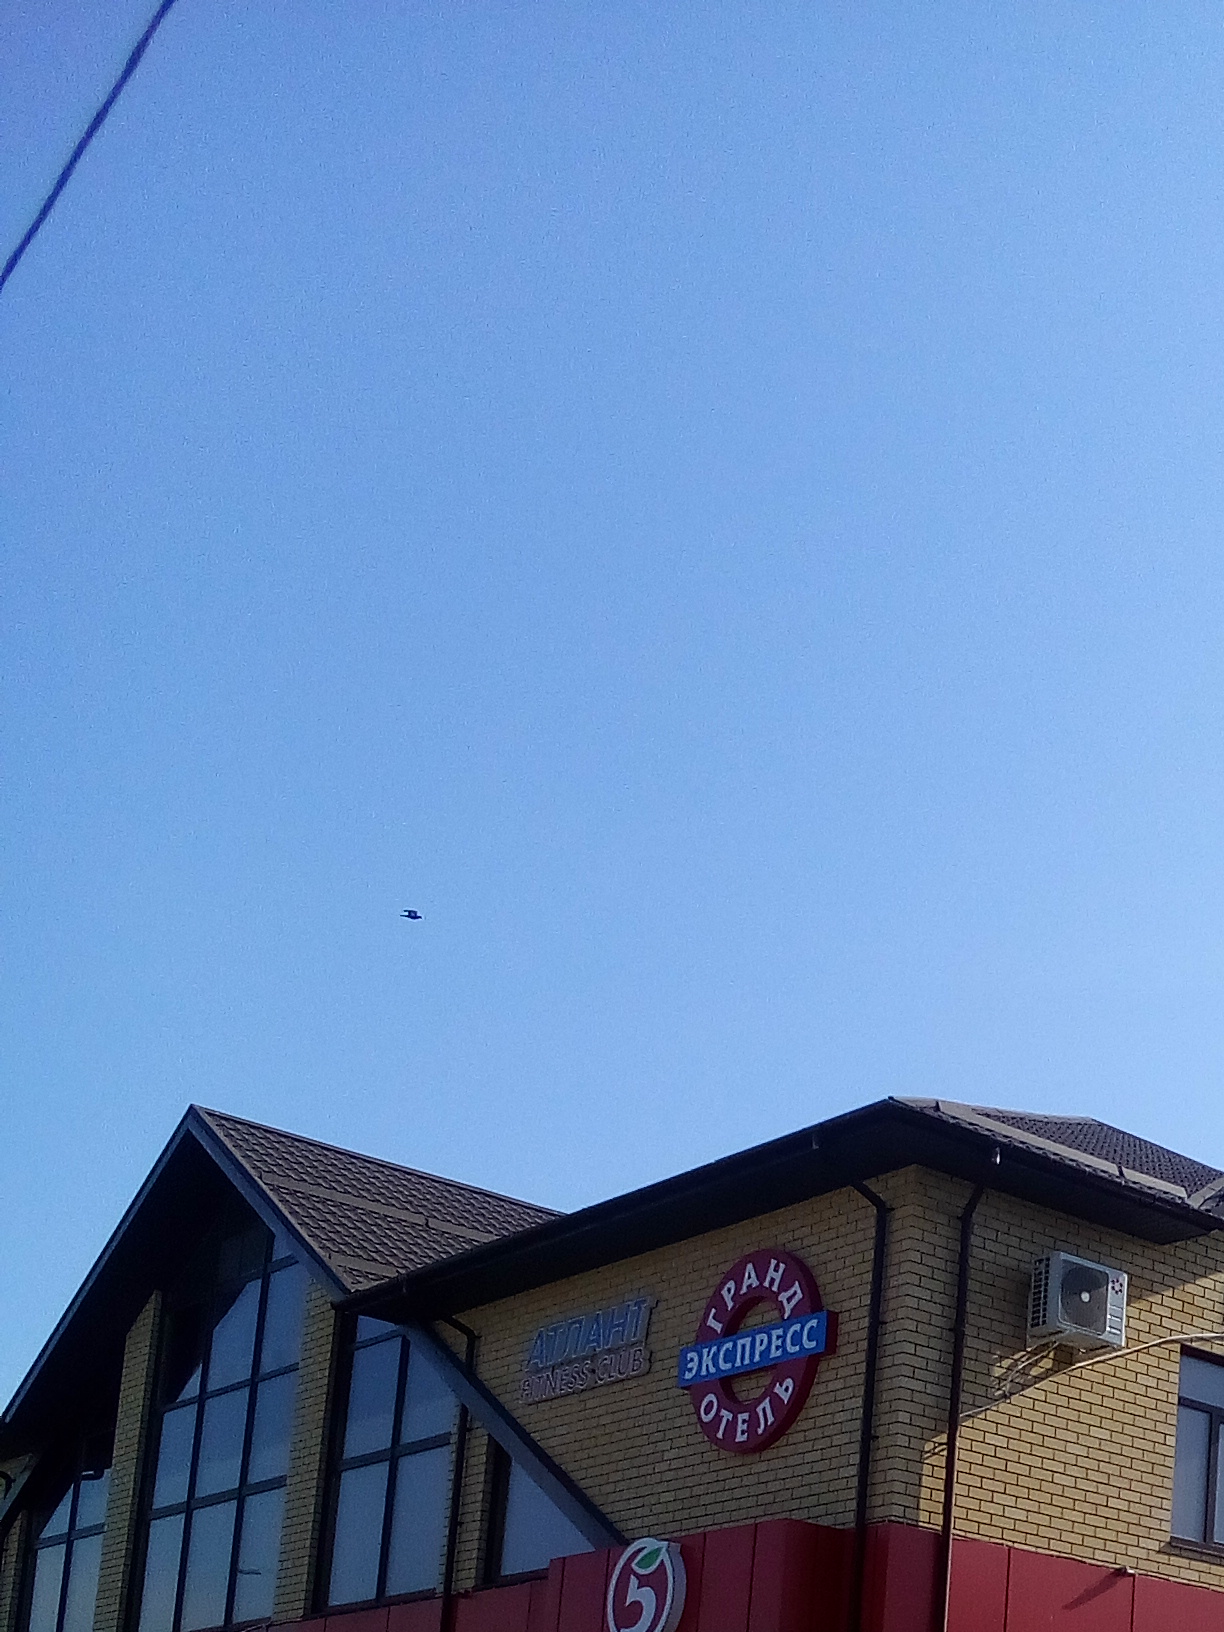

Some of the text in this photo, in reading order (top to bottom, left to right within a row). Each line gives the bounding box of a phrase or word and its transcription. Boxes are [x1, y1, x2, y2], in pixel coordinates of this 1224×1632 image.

[707, 1258, 803, 1334] ГРАНД
[527, 1296, 650, 1368] АТЛАНТ
[684, 1319, 819, 1379] ЭКСПРЕСС
[597, 1346, 644, 1384] CLUB
[700, 1378, 795, 1442] ОТЕЛЬ
